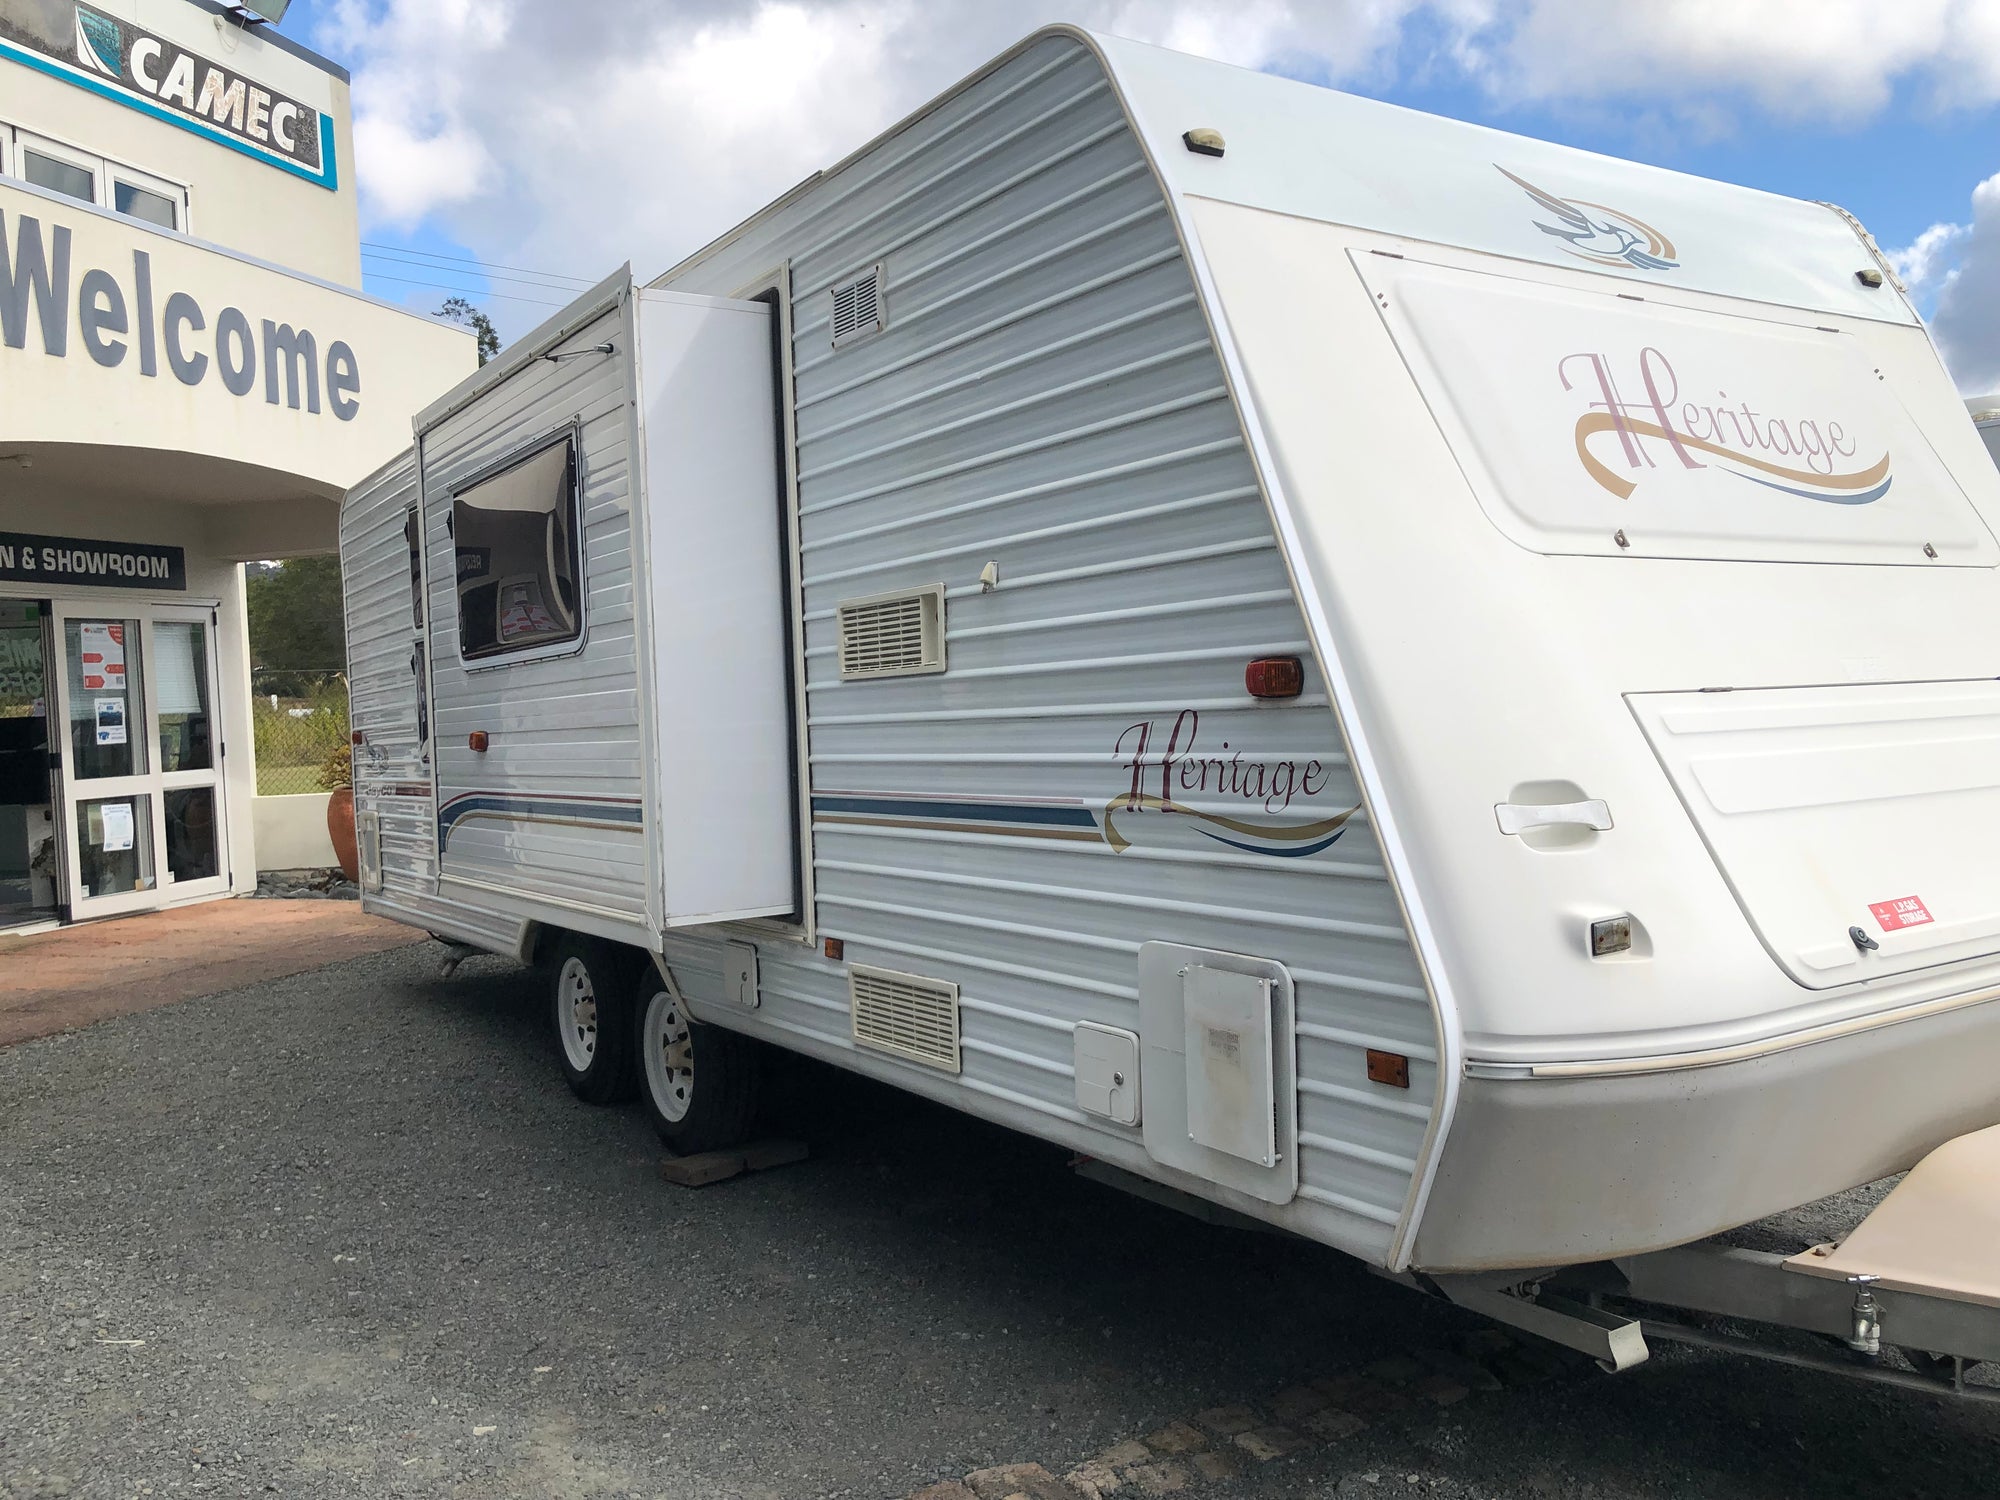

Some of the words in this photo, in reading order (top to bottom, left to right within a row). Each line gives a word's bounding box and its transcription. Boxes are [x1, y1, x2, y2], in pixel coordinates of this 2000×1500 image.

[130, 38, 297, 153] CAMEC
[0, 208, 361, 421] Welcome
[1558, 347, 1857, 475] Heritage
[22, 546, 37, 570] &
[42, 547, 170, 579] SHOWROOM
[1111, 708, 1331, 815] Heritage
